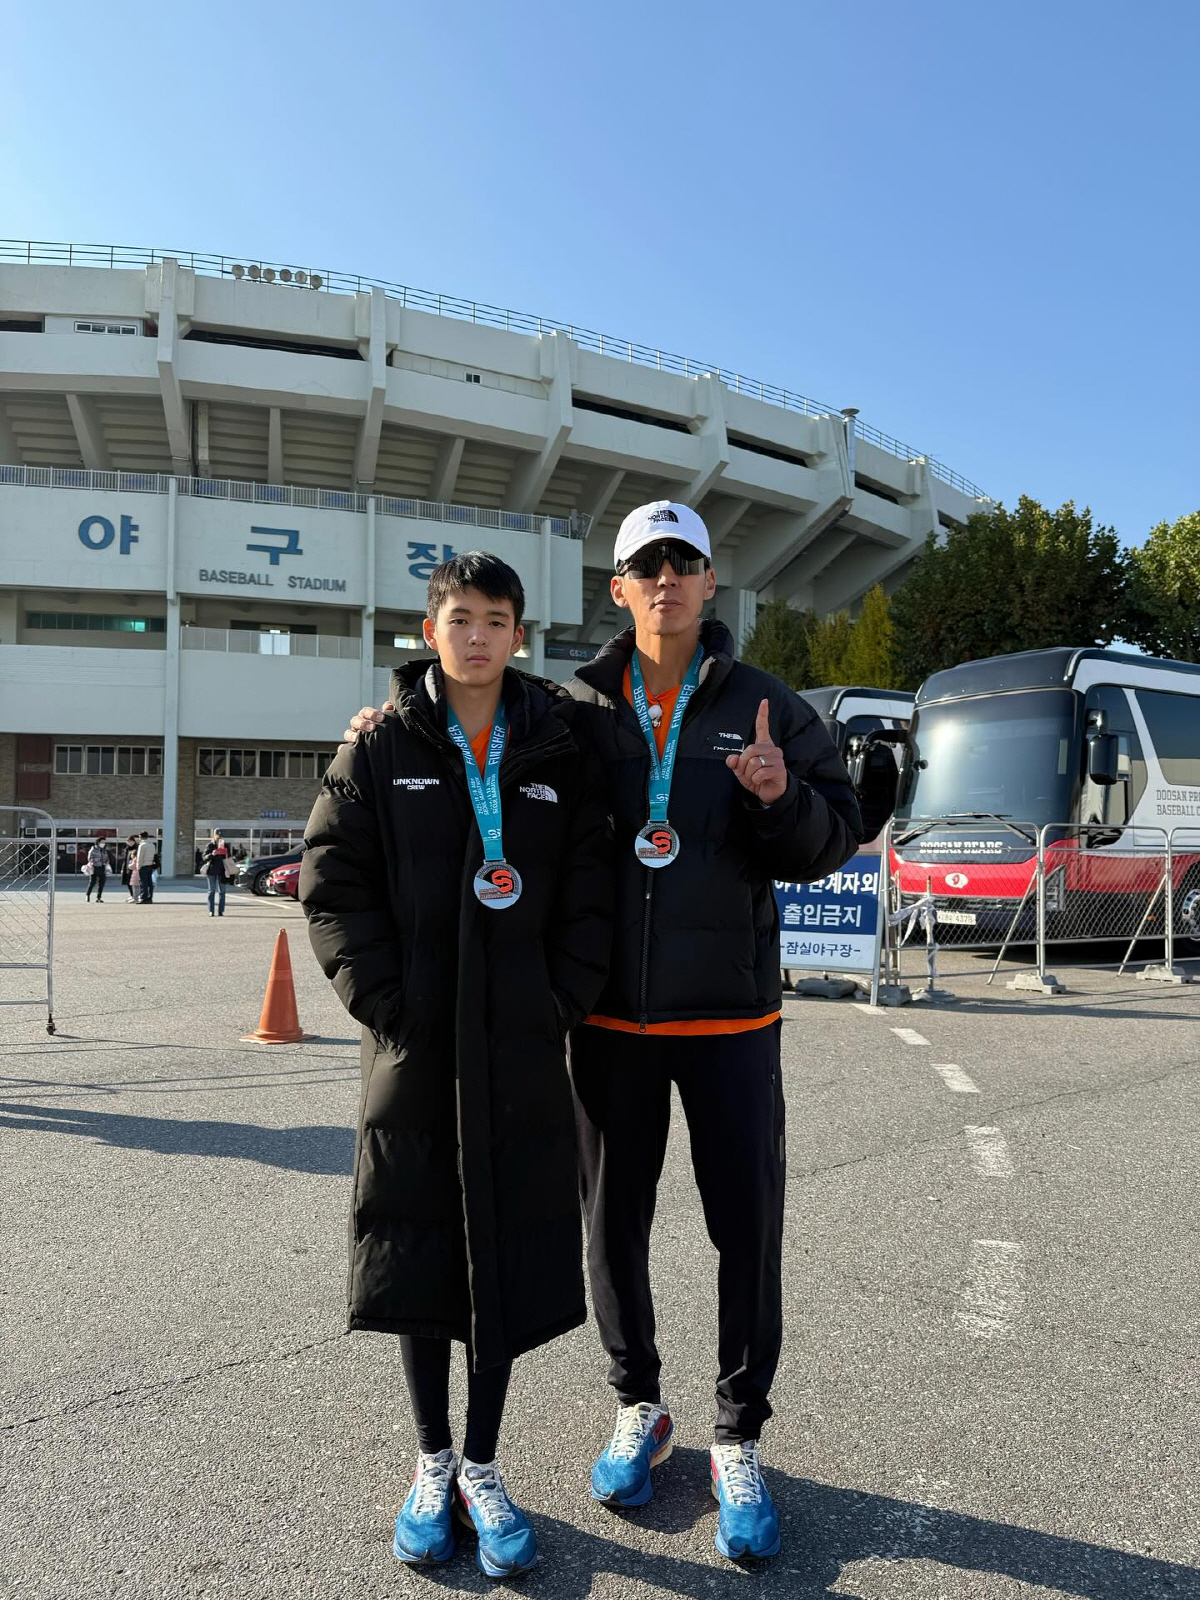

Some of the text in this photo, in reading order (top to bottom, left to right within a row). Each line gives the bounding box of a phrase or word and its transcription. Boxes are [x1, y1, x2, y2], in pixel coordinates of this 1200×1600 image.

[78, 514, 139, 555] 야
[246, 526, 303, 565] 구
[199, 569, 346, 592] BASEBALL STADIUM
[633, 685, 651, 733] FINISHER
[671, 684, 695, 729] FINISHER
[448, 724, 475, 766] FINISHER
[488, 725, 506, 765] FINISHER
[519, 785, 546, 794] NORTH
[527, 792, 546, 800] FACE
[1156, 789, 1200, 802] DOOSAN PR
[1156, 804, 1195, 816] BASEBALL
[920, 841, 1003, 854] DOOSAN BEARS
[783, 903, 862, 928] 출입금지
